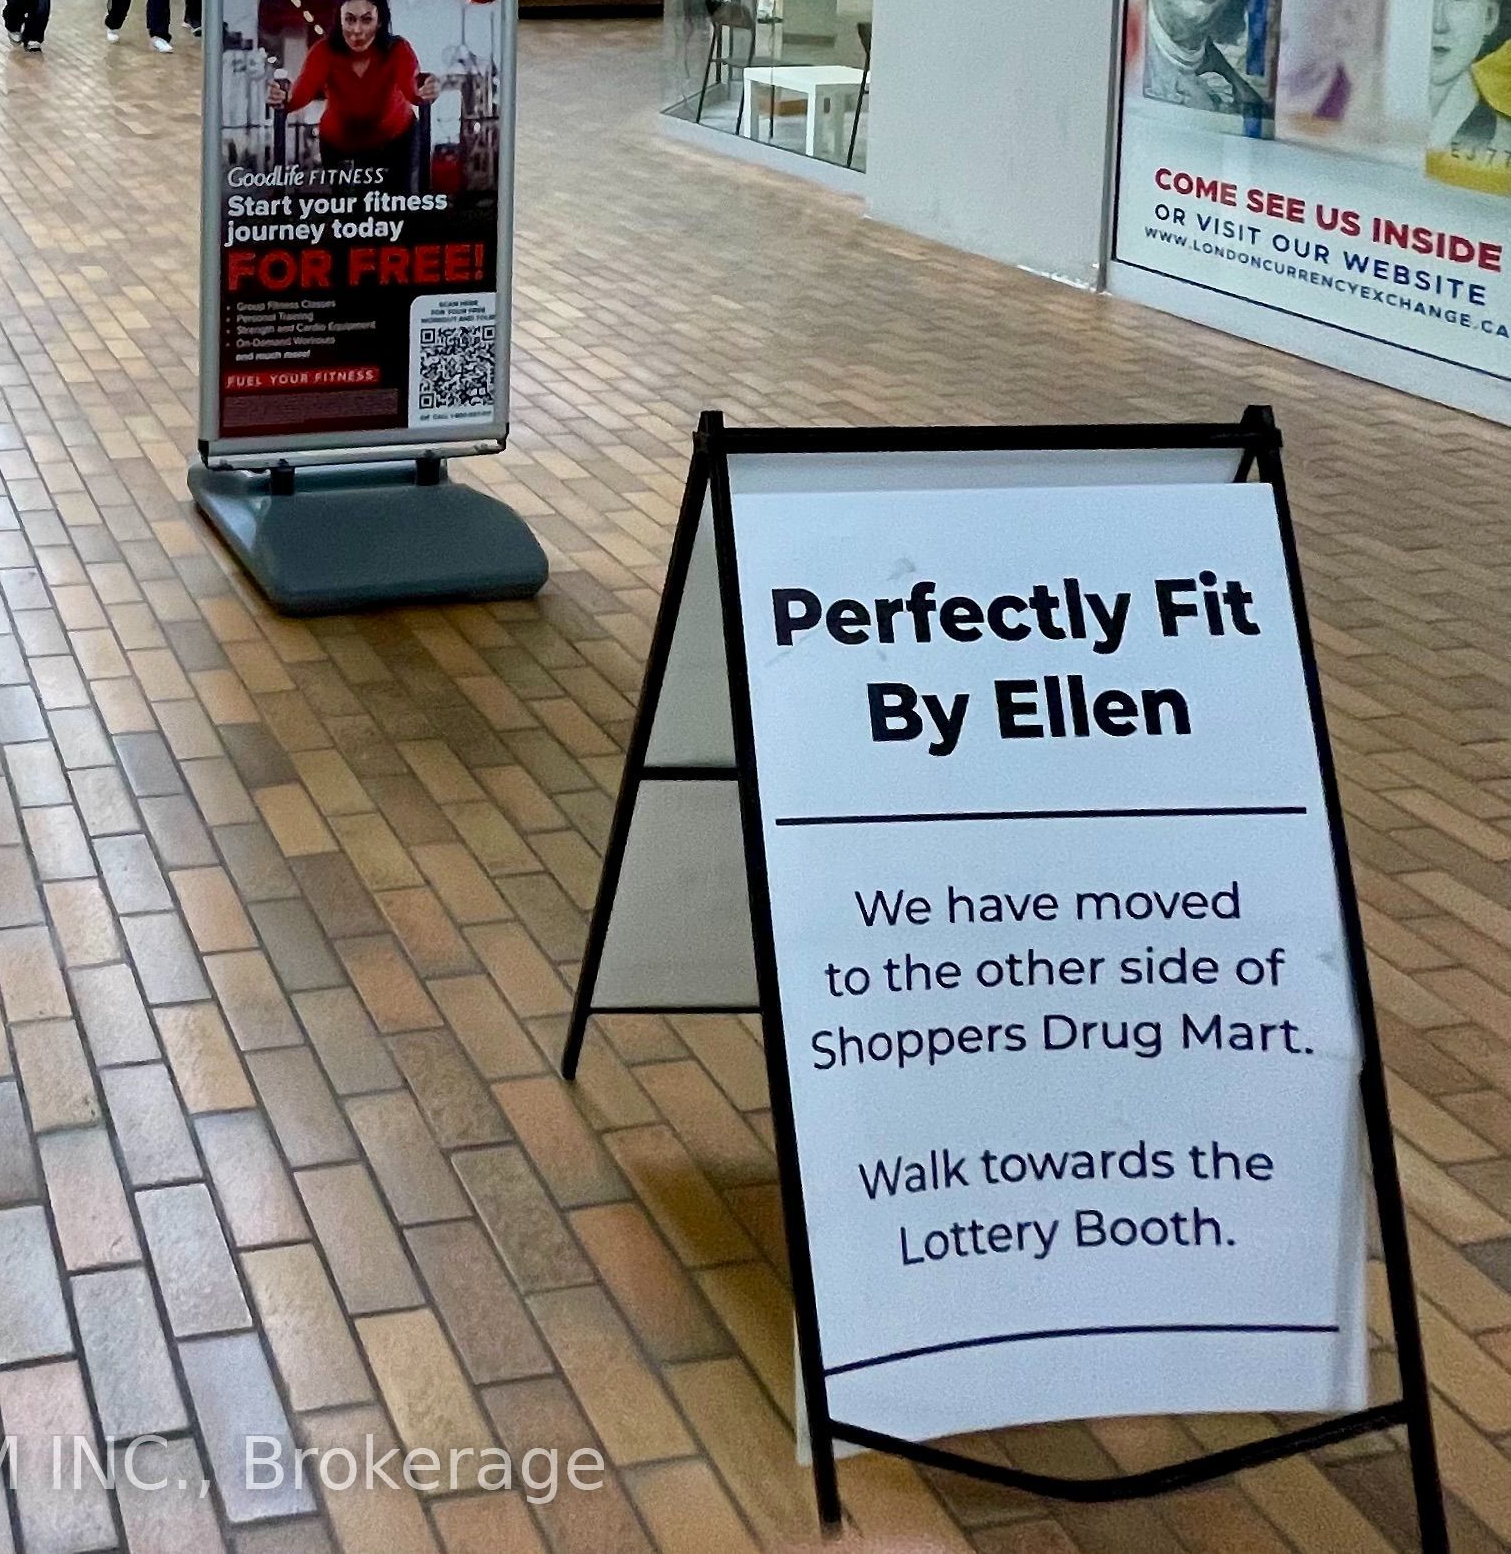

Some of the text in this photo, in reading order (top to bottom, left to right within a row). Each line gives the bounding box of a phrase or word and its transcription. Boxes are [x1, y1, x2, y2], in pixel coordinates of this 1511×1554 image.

[227, 165, 385, 187] GoodLife FITNESS
[227, 190, 448, 220] Start your fitness
[1154, 167, 1503, 273] COME SEE US INSIDE
[224, 217, 405, 247] journey today
[1154, 203, 1487, 306] OR VISIT OUR WEBSITE
[228, 243, 485, 291] FOR FREE!
[226, 369, 375, 388] FUEL YOUR FITNESS
[772, 571, 1261, 654] Perfectly Fit
[867, 675, 1192, 756] By Ellen
[855, 881, 1241, 927] We have moved
[824, 946, 1286, 996] to the other side of
[811, 1013, 1314, 1070] Shoppers Drug Mart.
[859, 1140, 1274, 1200] Walk towards the
[901, 1207, 1235, 1266] Lottery Booth.
